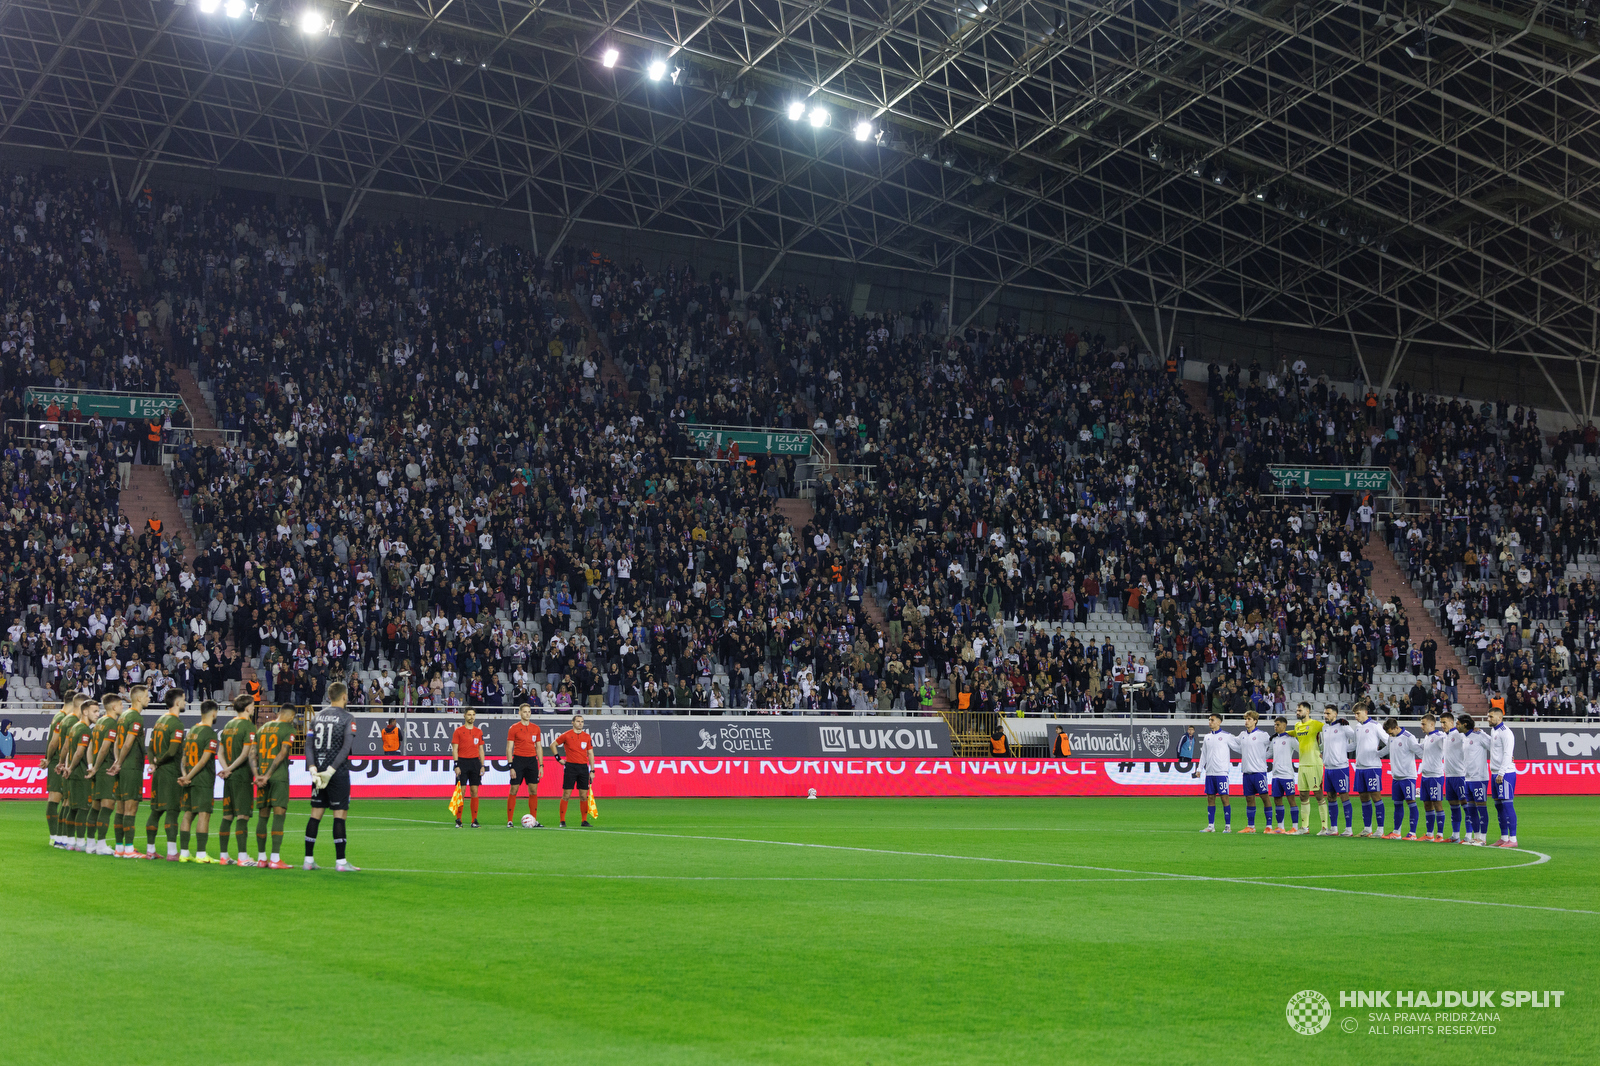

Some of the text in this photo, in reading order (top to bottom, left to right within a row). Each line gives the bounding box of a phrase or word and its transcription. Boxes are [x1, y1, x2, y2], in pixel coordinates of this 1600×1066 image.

[140, 399, 176, 408] IZLAZ
[143, 408, 172, 416] EXI
[775, 435, 808, 444] IZLAZ
[778, 443, 804, 451] EXIT
[1353, 472, 1386, 480] IZLAZ
[1356, 480, 1383, 488] EXIT
[314, 722, 334, 750] 31
[846, 728, 938, 750] LUKOIL
[258, 733, 278, 759] 42
[722, 739, 773, 753] QUELLE
[1066, 732, 1136, 751] Karlovačko
[1219, 781, 1228, 790] 30
[1338, 779, 1347, 788] 31
[1368, 778, 1378, 787] 22
[1429, 786, 1438, 796] 32
[1473, 787, 1484, 797] 23
